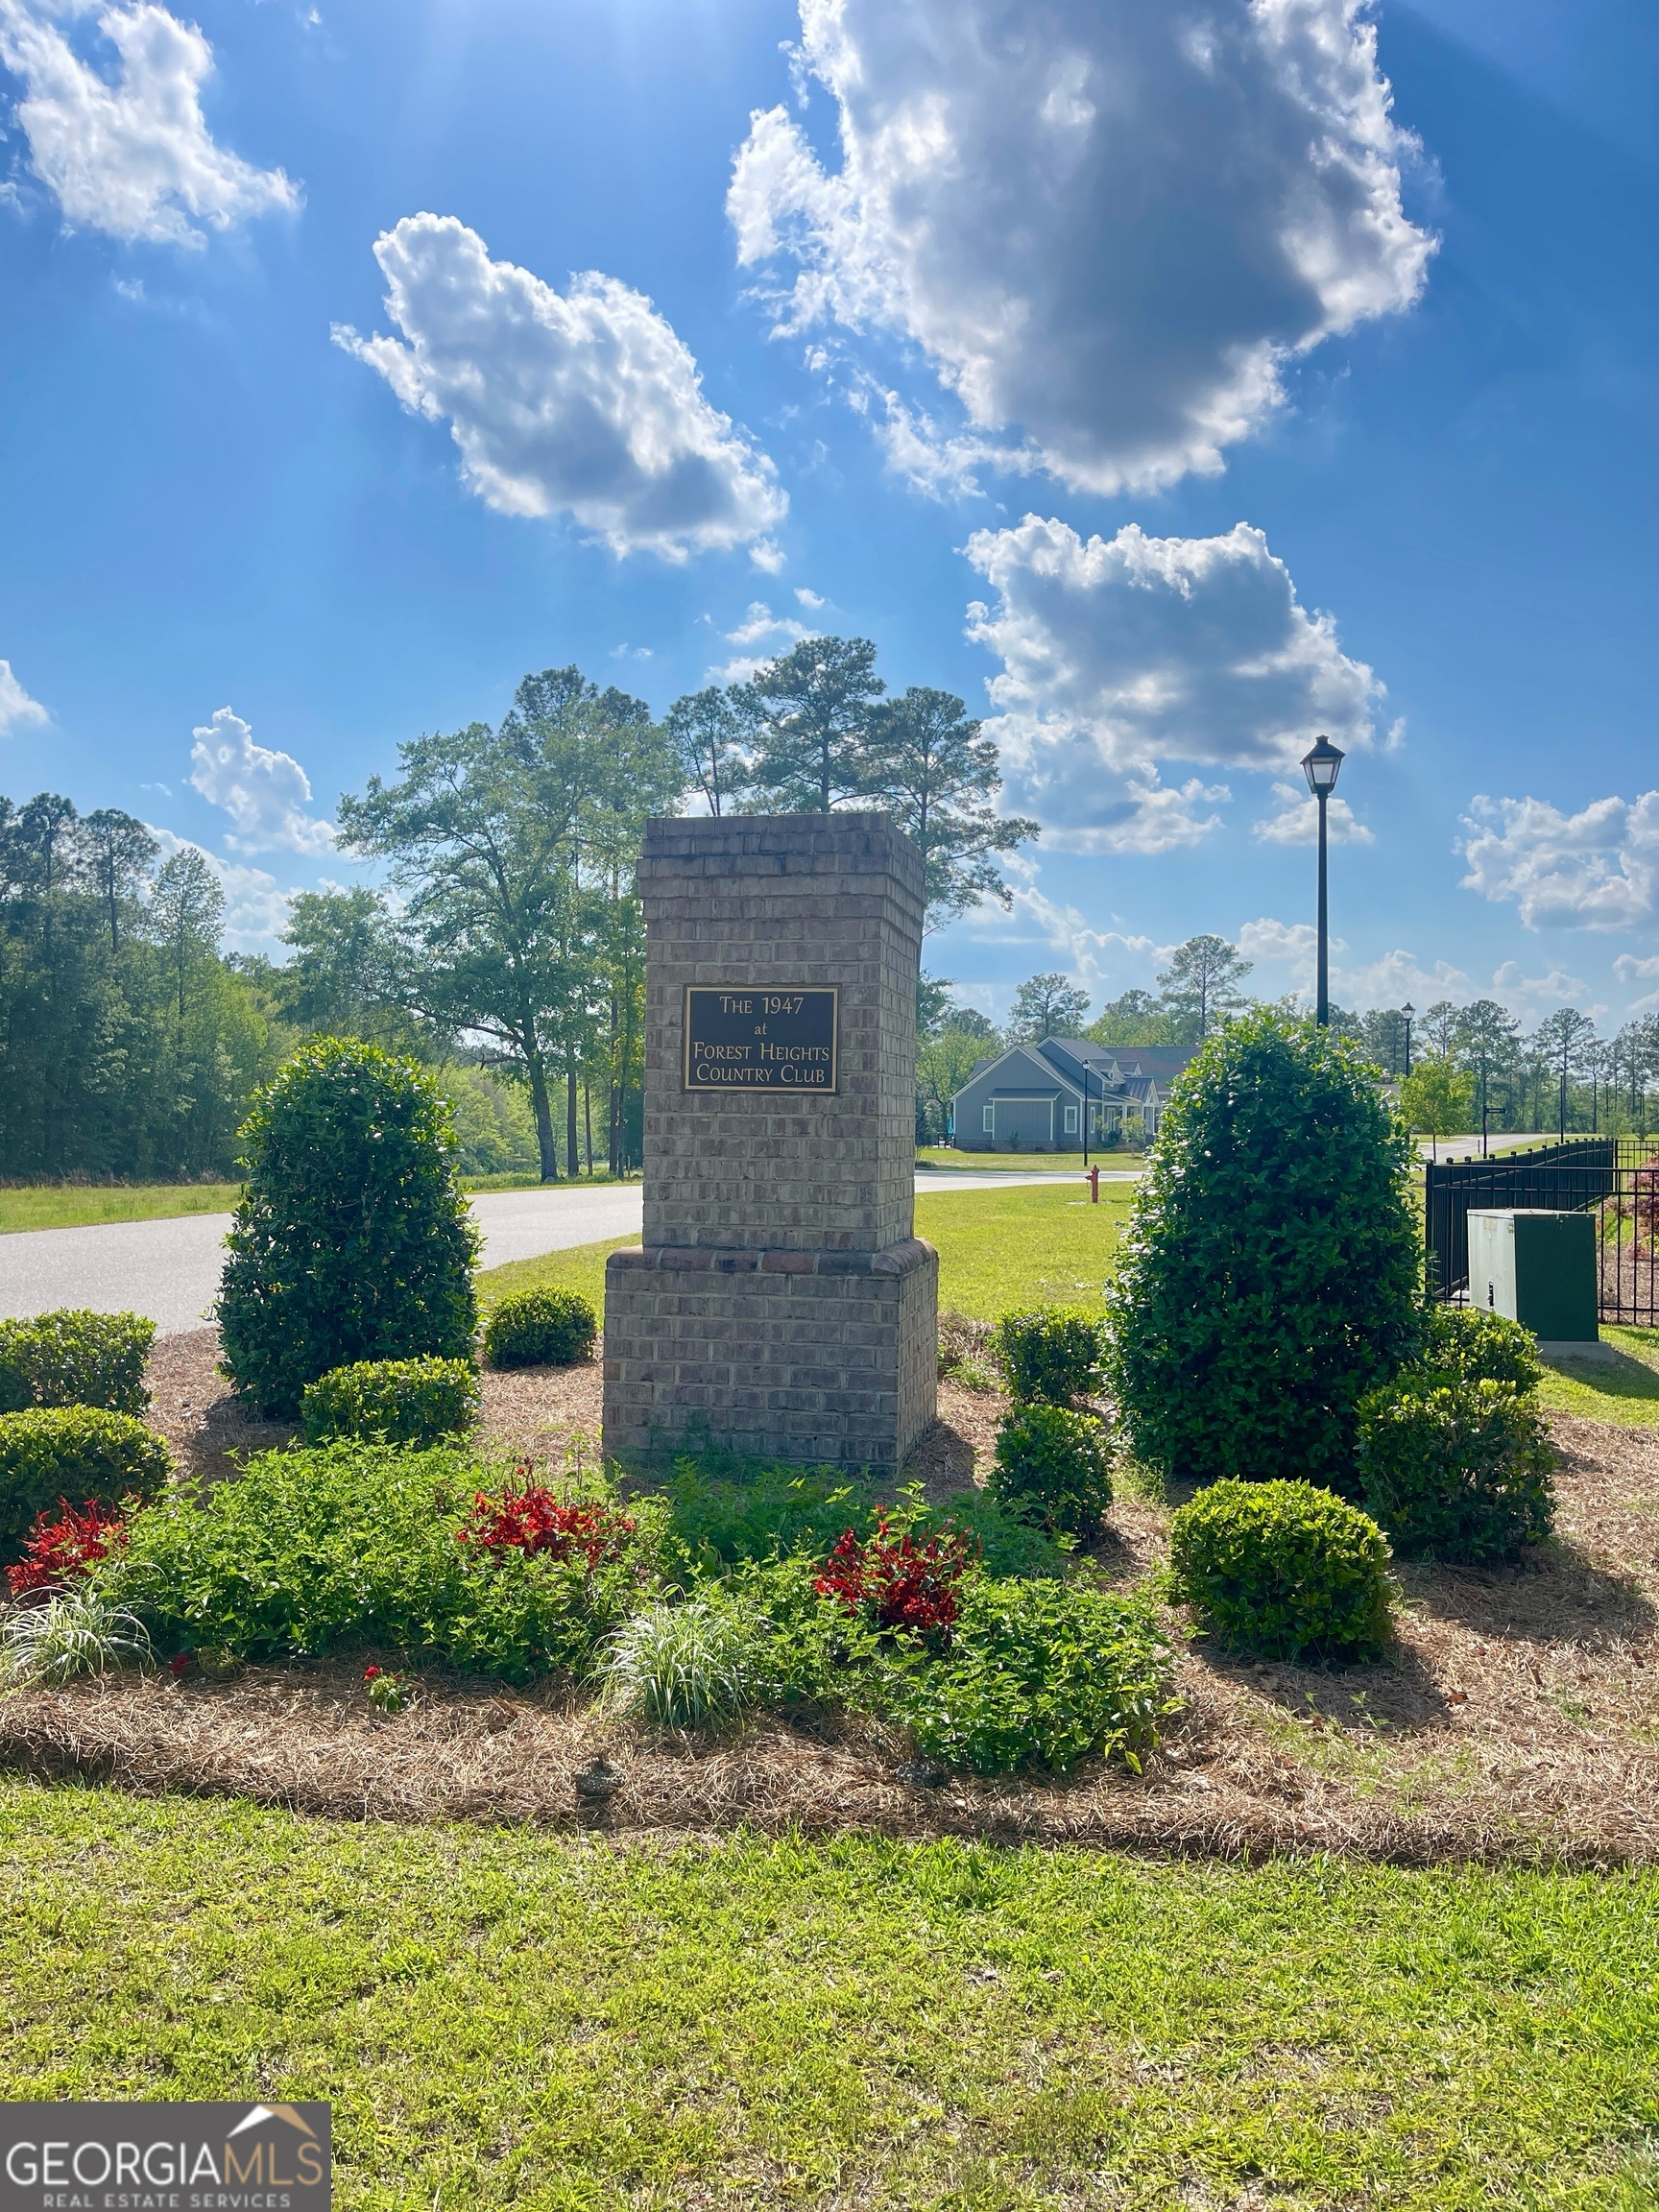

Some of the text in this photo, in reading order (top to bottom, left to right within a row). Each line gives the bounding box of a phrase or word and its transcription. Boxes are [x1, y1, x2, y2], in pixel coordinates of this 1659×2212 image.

[761, 997, 804, 1015] 1947
[754, 1022, 768, 1035] at
[693, 1042, 830, 1061] FOREST HEIGHTS
[696, 1063, 825, 1083] COUNTRY CLUB
